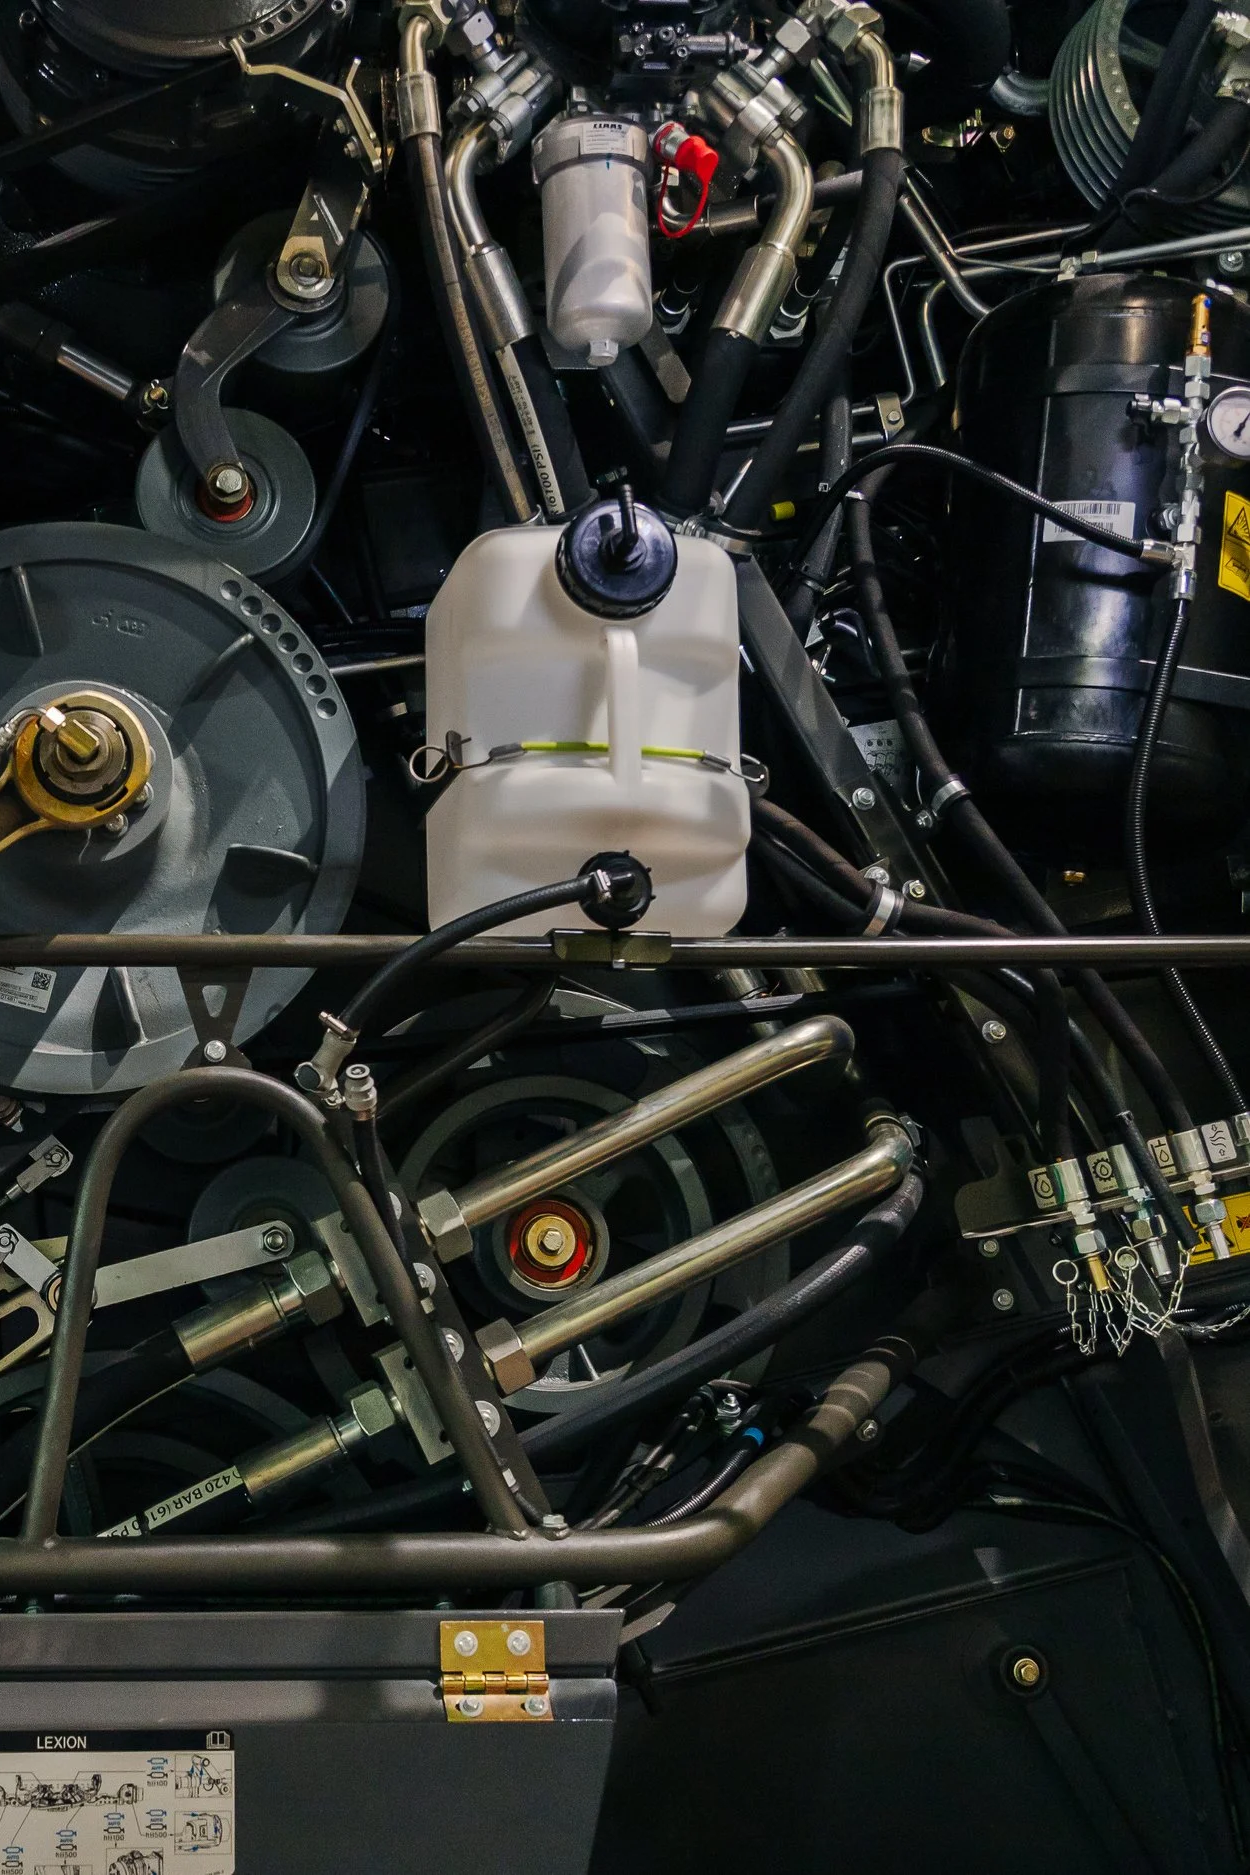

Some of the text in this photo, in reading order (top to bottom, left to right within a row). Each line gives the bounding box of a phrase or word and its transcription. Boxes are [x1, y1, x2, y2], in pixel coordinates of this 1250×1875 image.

[531, 443, 547, 469] PSI)
[204, 1475, 231, 1493] 420
[173, 1487, 203, 1510] BAR
[36, 1736, 87, 1749] LEXION
